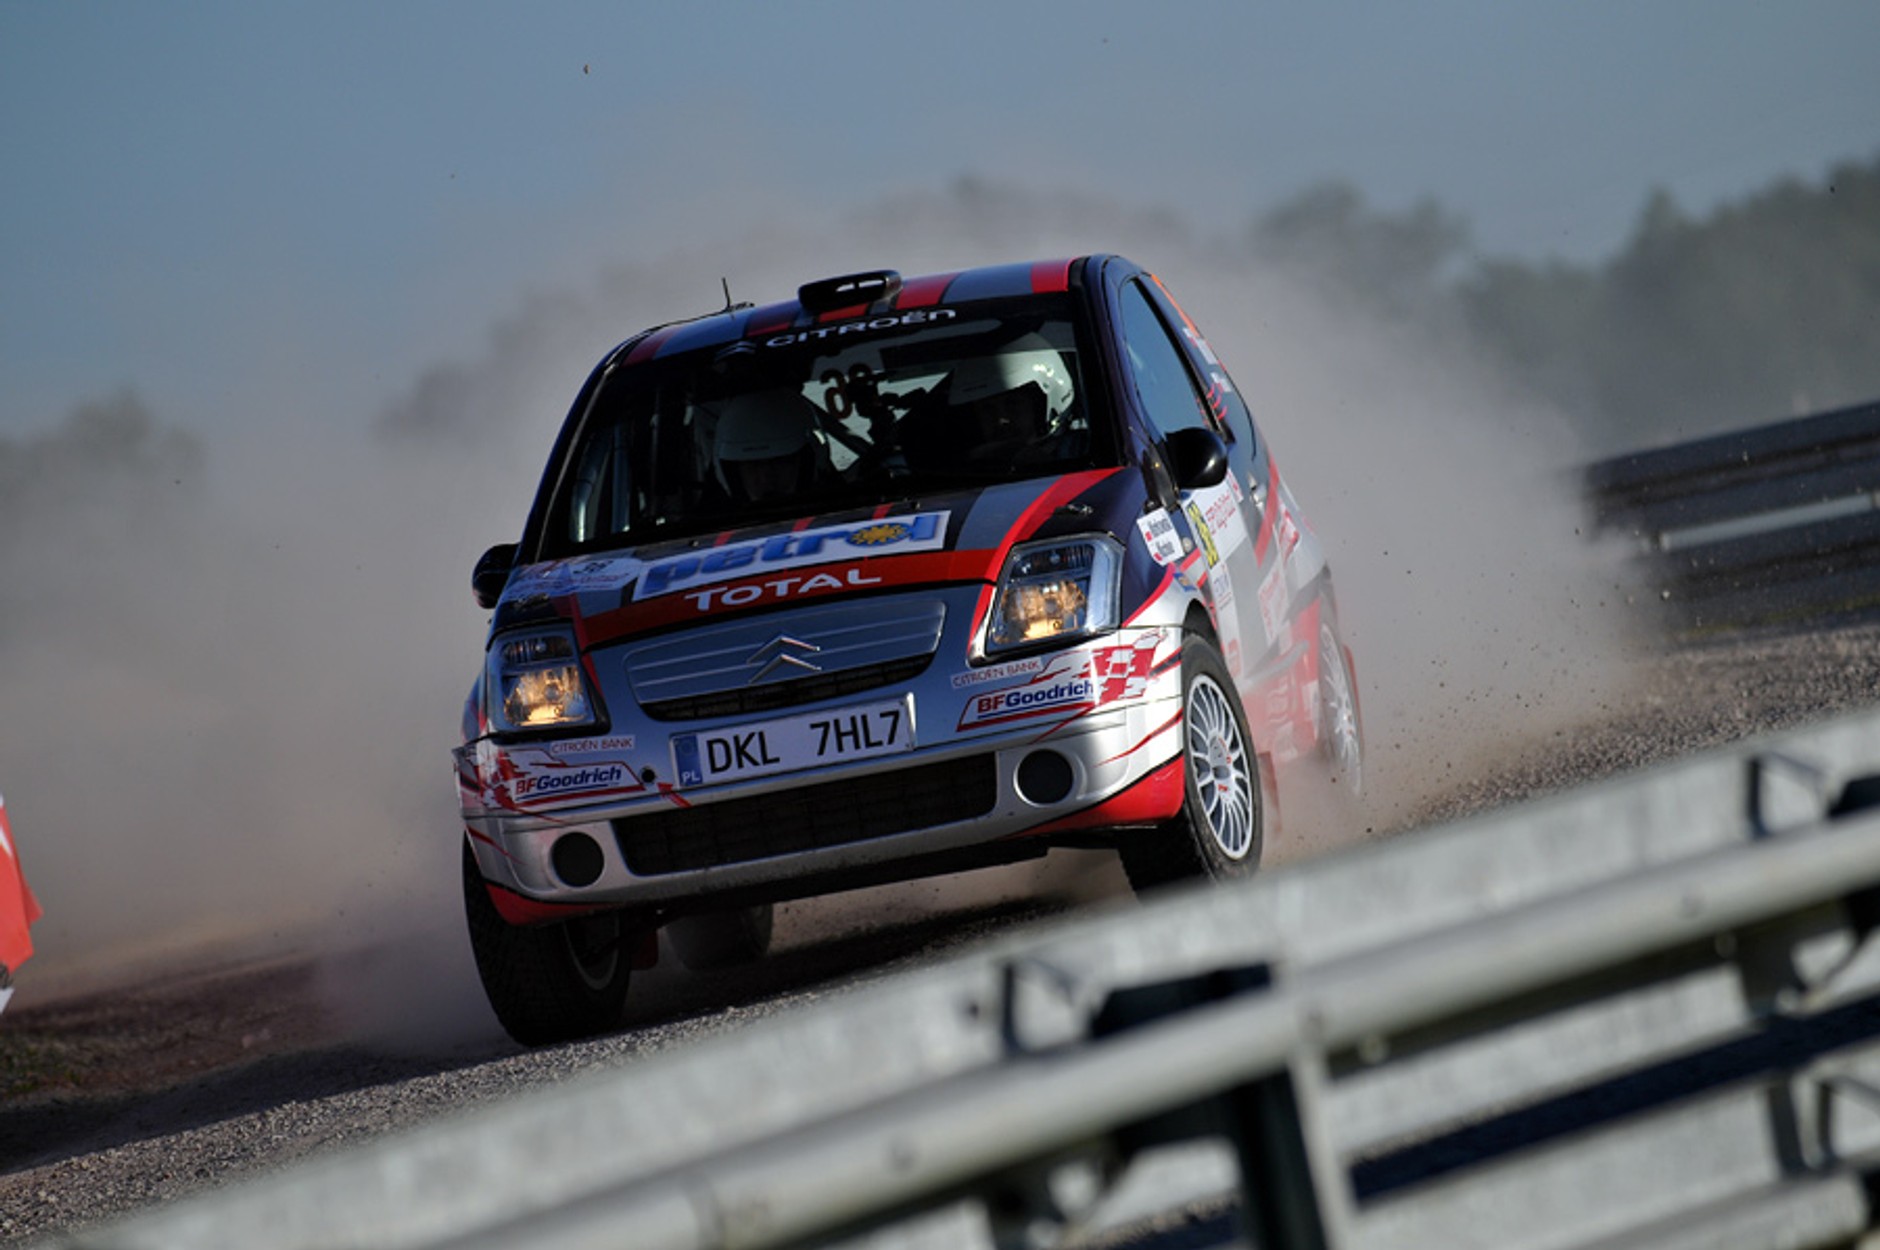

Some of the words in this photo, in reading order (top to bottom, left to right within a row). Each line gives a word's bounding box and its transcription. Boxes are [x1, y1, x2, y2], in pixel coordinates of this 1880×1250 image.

[684, 569, 882, 611] TOTAL
[1007, 660, 1040, 676] BANK
[977, 680, 1094, 713] BFGoodrich
[601, 738, 632, 750] BANK
[706, 731, 781, 774] DKL
[810, 709, 900, 757] 7HL7
[515, 766, 622, 795] BFGoodrich
[681, 770, 700, 783] PL
